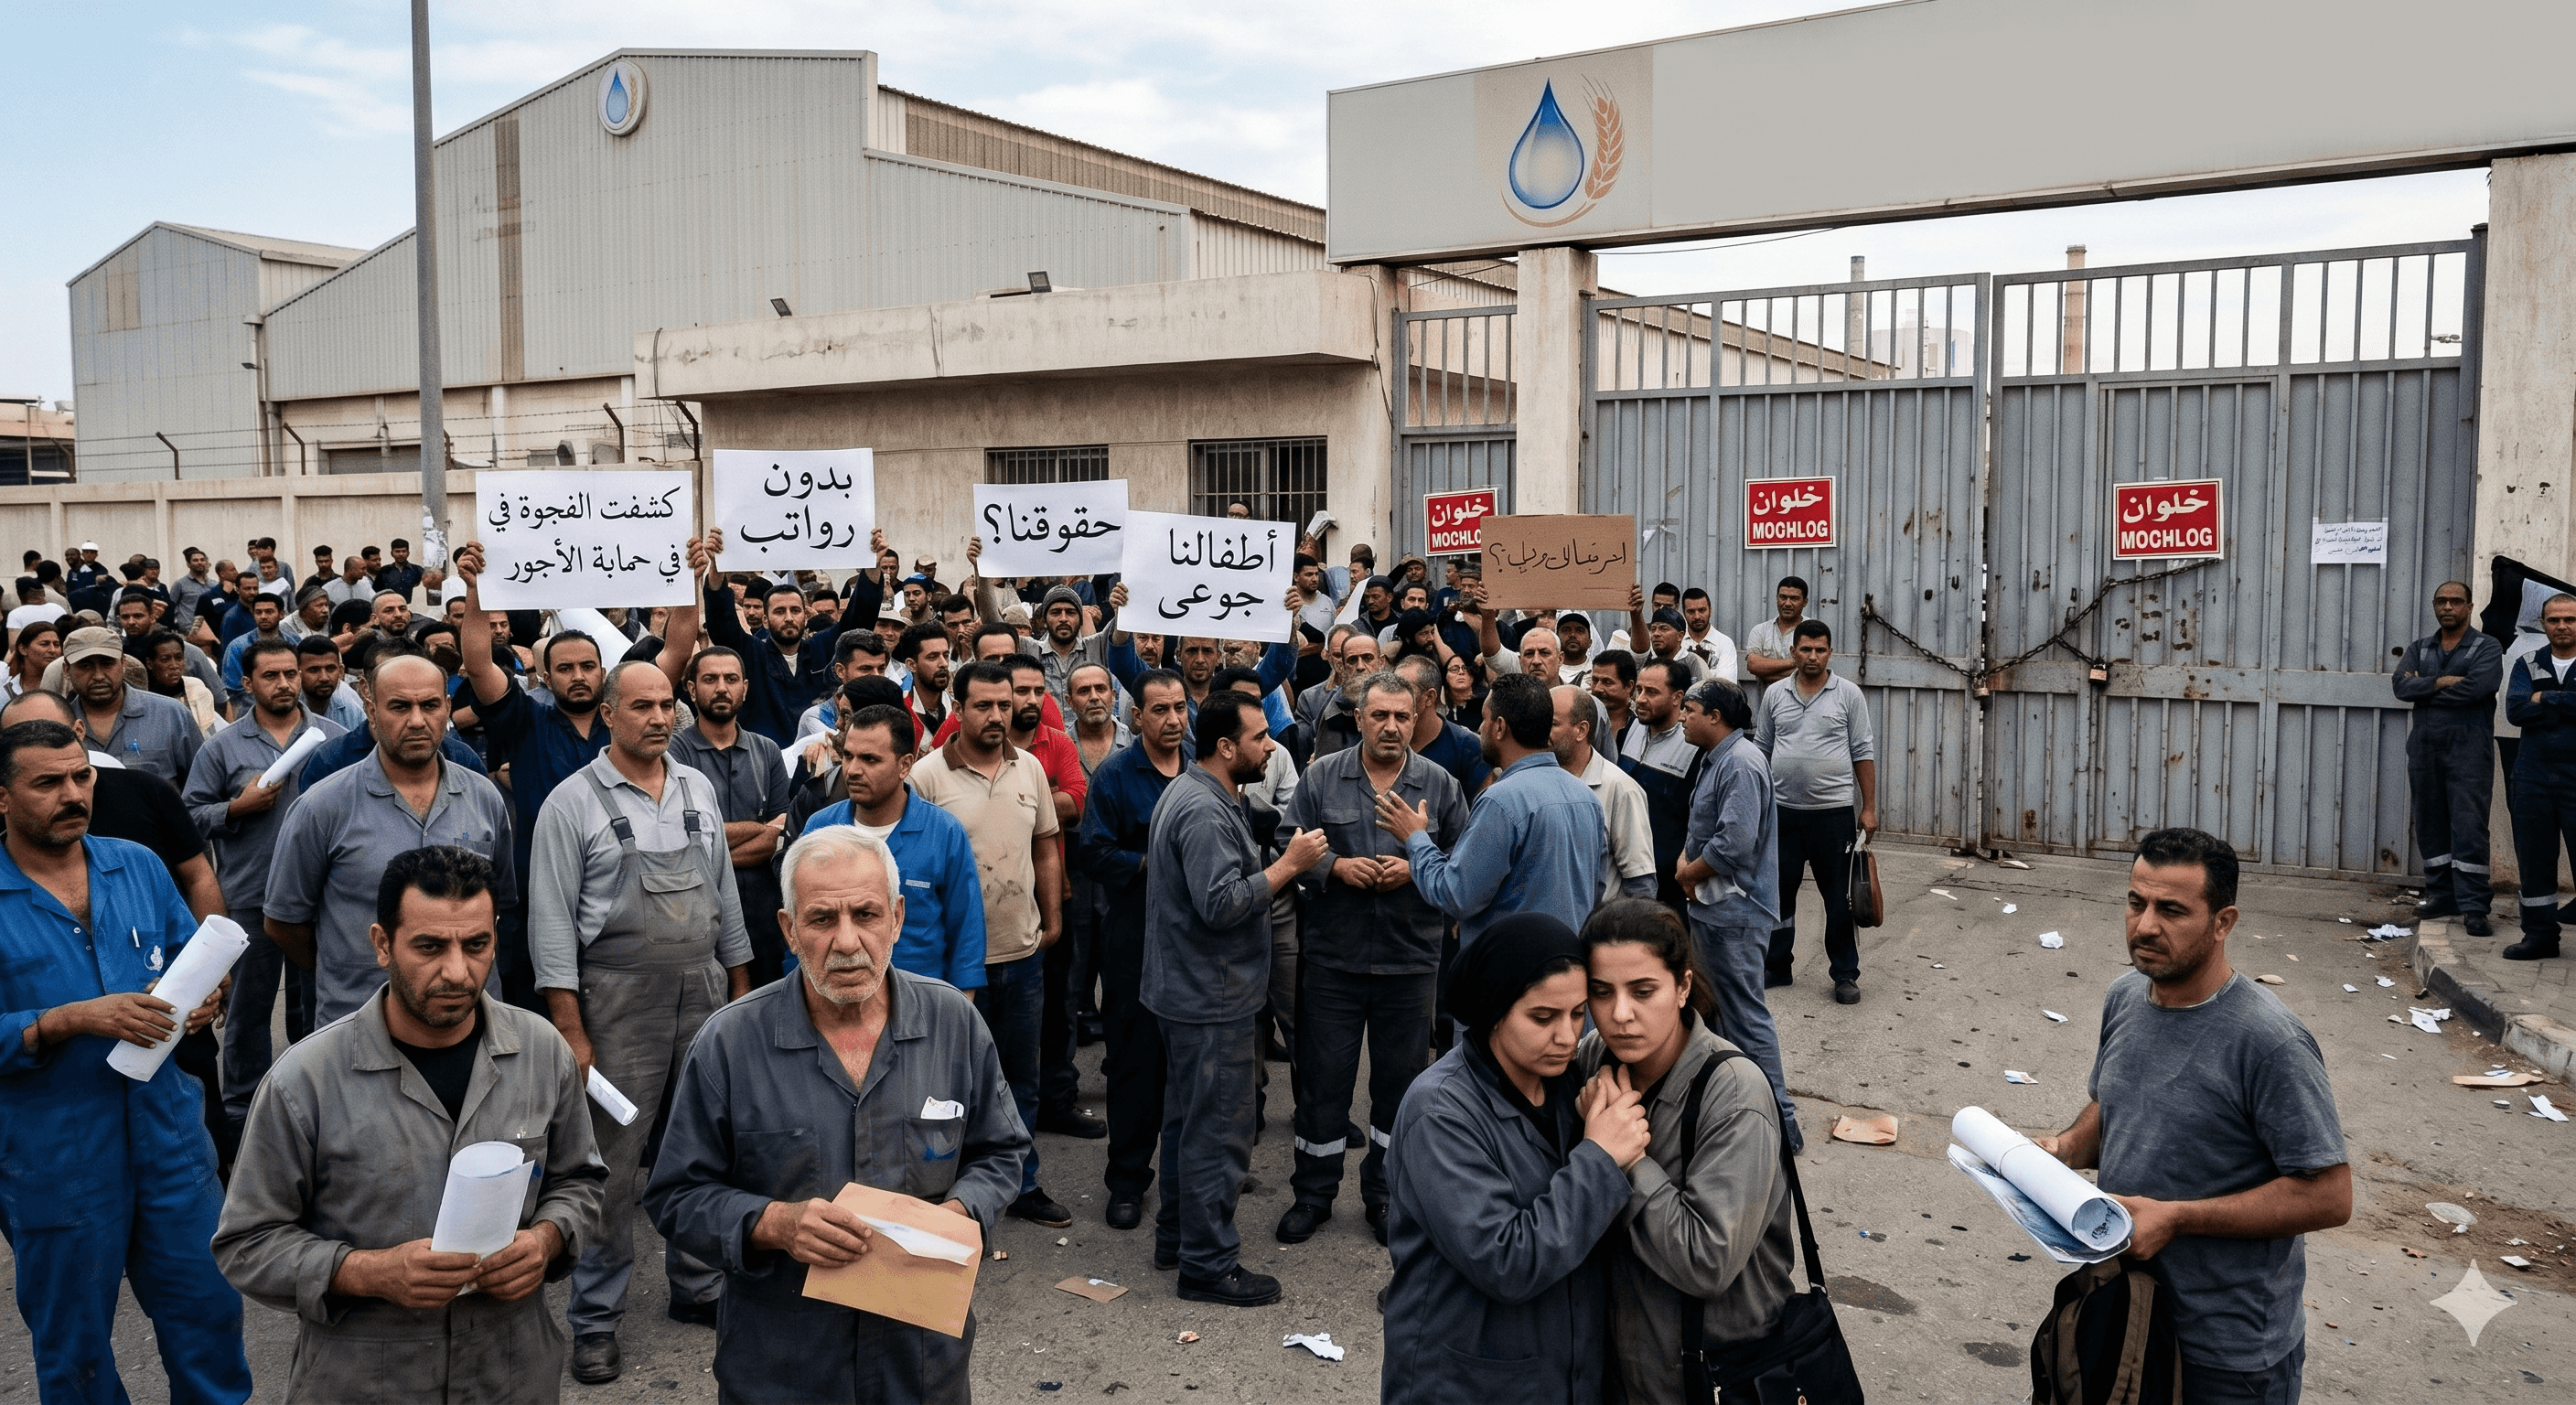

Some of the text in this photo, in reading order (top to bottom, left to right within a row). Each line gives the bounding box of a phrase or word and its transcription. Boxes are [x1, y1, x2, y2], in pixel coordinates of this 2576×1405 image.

[765, 464, 853, 500] بدون
[488, 486, 682, 533] كشفت الفجوة في
[740, 504, 856, 553] رواتب
[983, 502, 1122, 553] حقوقنا؟
[1753, 520, 1829, 540] MOCHLOG
[1169, 527, 1278, 574] أطفالنا
[1432, 529, 1482, 549] MOCHLO
[2120, 527, 2214, 550] MOCHLOG
[503, 538, 583, 584] الأجور
[659, 543, 682, 584] في
[1158, 584, 1265, 621] جوعى
